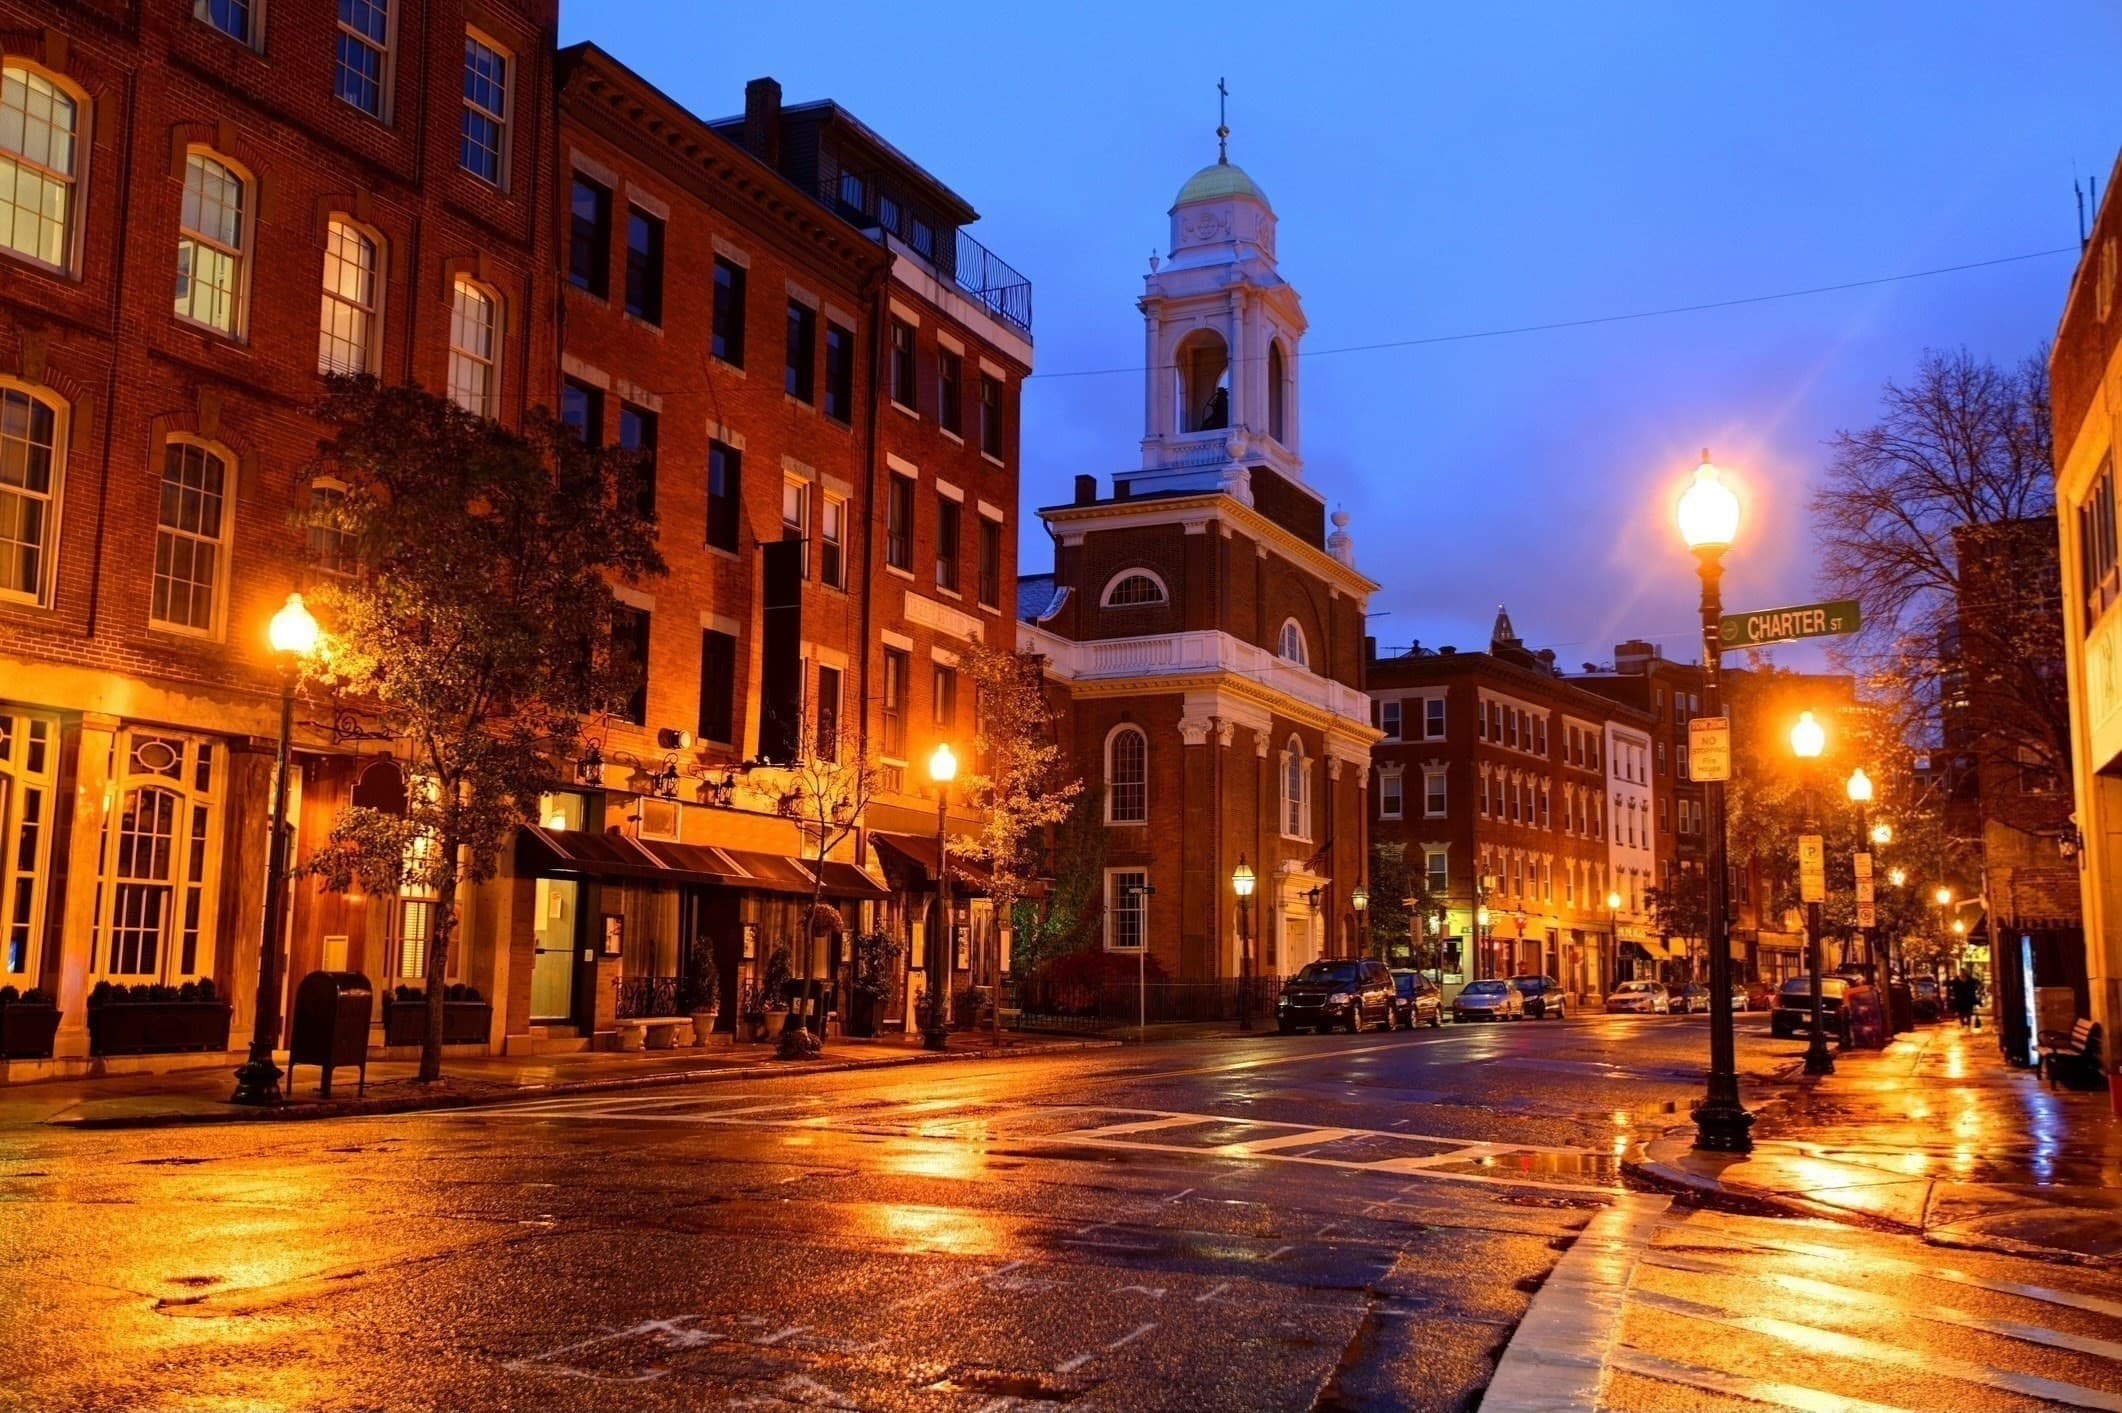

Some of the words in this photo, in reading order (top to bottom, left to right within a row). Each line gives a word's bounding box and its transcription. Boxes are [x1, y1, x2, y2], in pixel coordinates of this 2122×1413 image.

[1747, 609, 1826, 640] CHARTER
[1830, 617, 1842, 631] ST
[1701, 736, 1717, 745] NO
